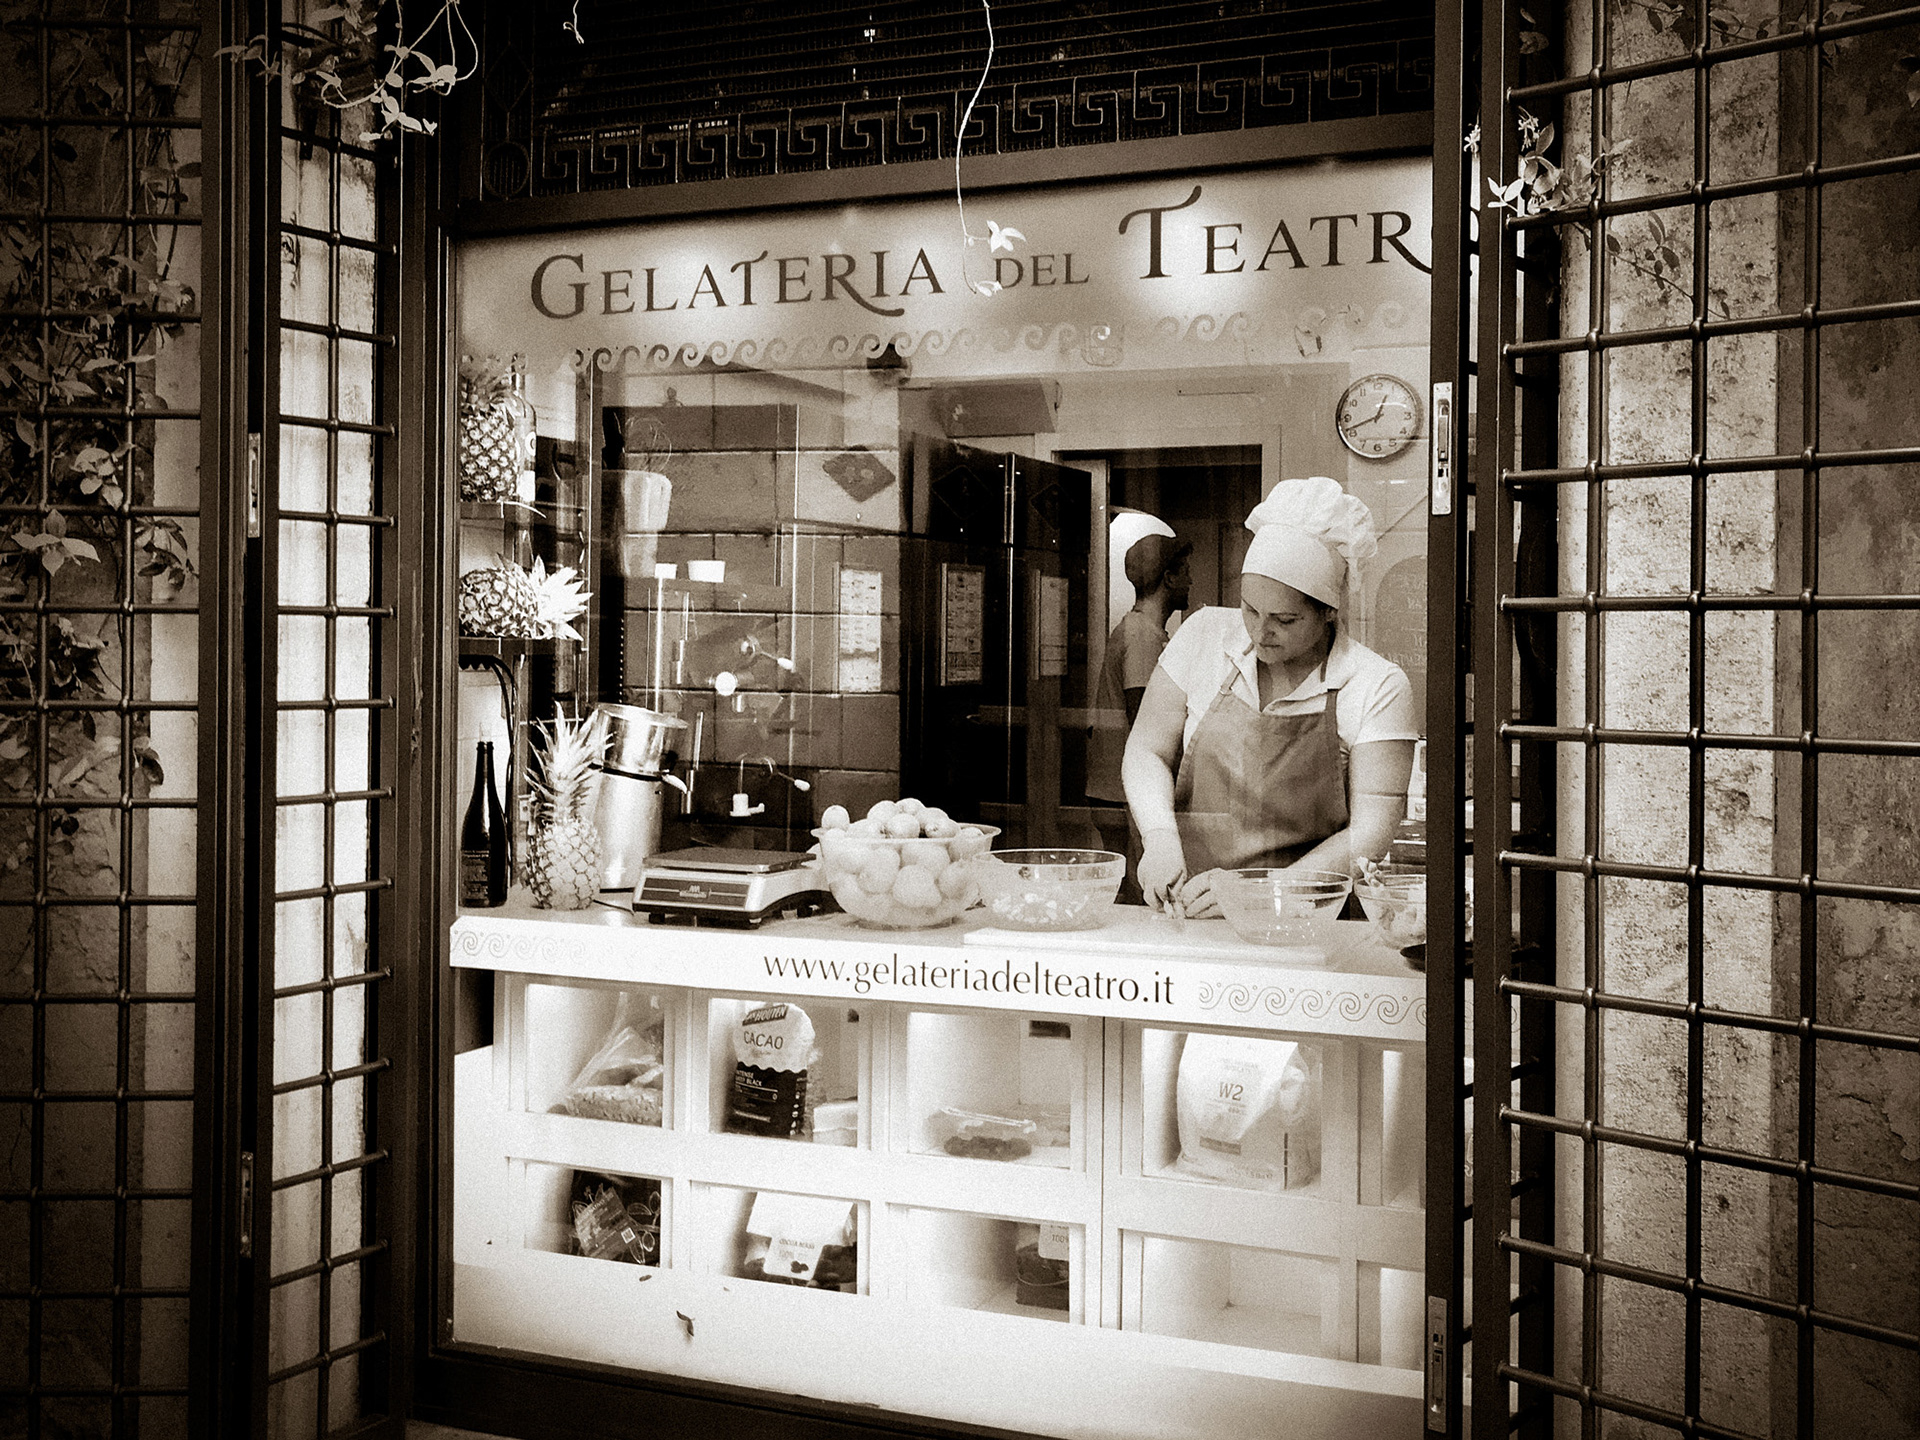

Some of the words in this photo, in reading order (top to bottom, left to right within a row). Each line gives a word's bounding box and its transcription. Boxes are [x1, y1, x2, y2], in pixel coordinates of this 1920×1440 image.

[531, 248, 945, 319] GELATERIA
[993, 253, 1090, 290] DEL
[1118, 185, 1432, 281] TEATR
[1344, 413, 1351, 422] 9
[1404, 412, 1411, 420] 3
[1360, 439, 1367, 449] 7
[1373, 443, 1382, 452] 6
[1388, 438, 1397, 447] 5
[763, 953, 1175, 1005] www.gelateriadelteatro.it
[743, 1030, 784, 1050] CACAO
[1219, 1081, 1244, 1101] W2
